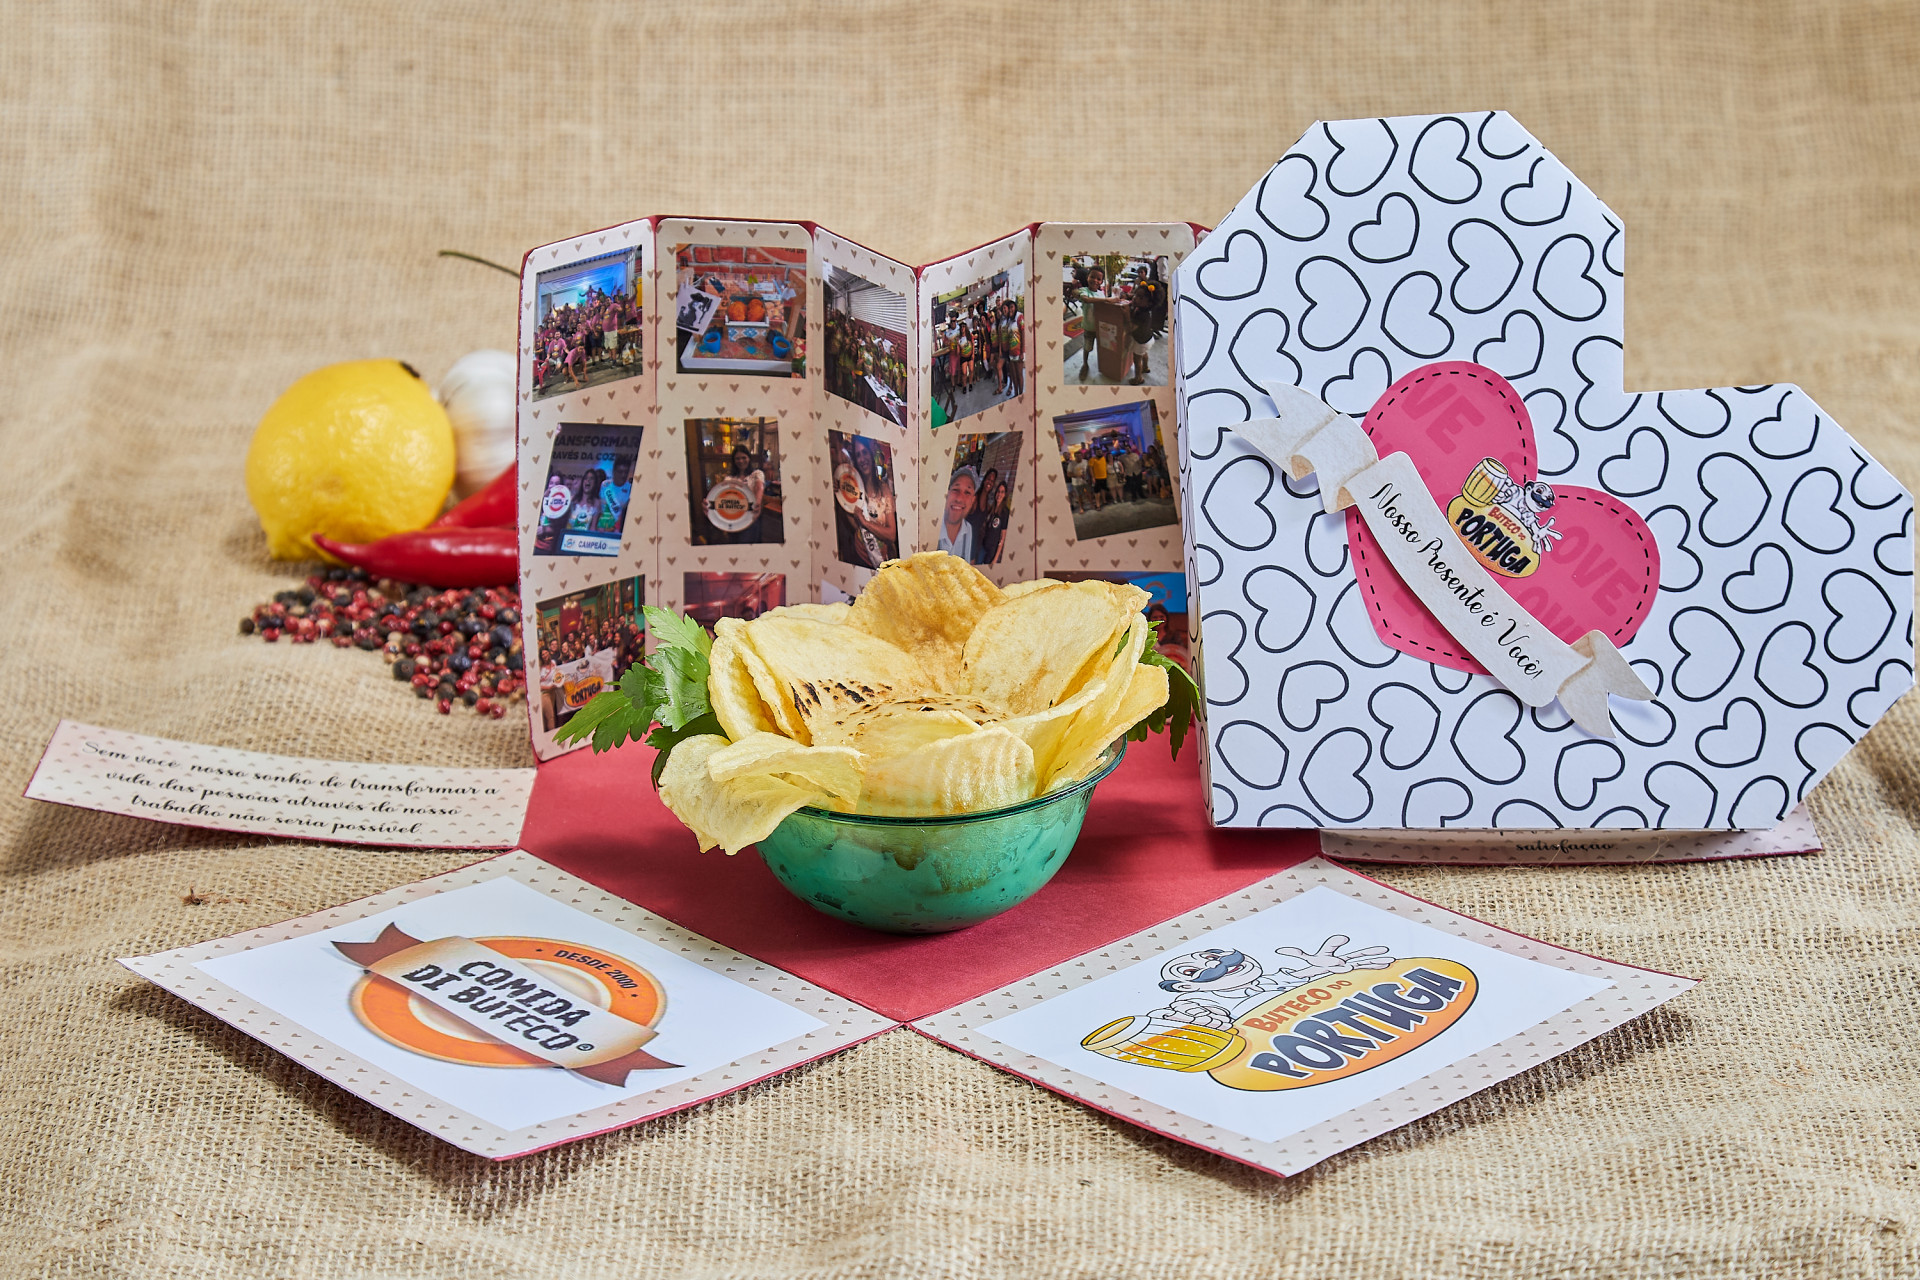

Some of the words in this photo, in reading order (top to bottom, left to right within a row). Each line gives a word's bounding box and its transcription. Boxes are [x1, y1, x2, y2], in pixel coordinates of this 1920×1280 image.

[1455, 507, 1532, 574] PORTUGA
[1488, 506, 1521, 534] BUTECO
[1368, 482, 1421, 542] Nosso
[1417, 536, 1484, 614] Presente
[1481, 612, 1498, 627] é
[570, 680, 601, 704] PORTUGA
[82, 741, 129, 760] Sem
[190, 763, 248, 778] nosso
[252, 771, 314, 786] sonho
[320, 776, 345, 788] de
[350, 777, 480, 797] transformar
[485, 786, 500, 795] a
[106, 771, 152, 787] vida
[158, 778, 197, 794] das
[200, 788, 282, 804] pessoas
[286, 795, 367, 811] através
[371, 801, 399, 814] do
[402, 806, 463, 816] nosso
[131, 793, 224, 818] trabalho
[274, 814, 330, 828] seria
[401, 964, 462, 991] DI
[554, 949, 612, 970] DESDE
[605, 969, 638, 989] 2000
[458, 961, 591, 1027] COMIDA
[1243, 987, 1333, 1033] BUTECO
[1326, 979, 1353, 991] DO
[1249, 967, 1465, 1079] PORTUGA
